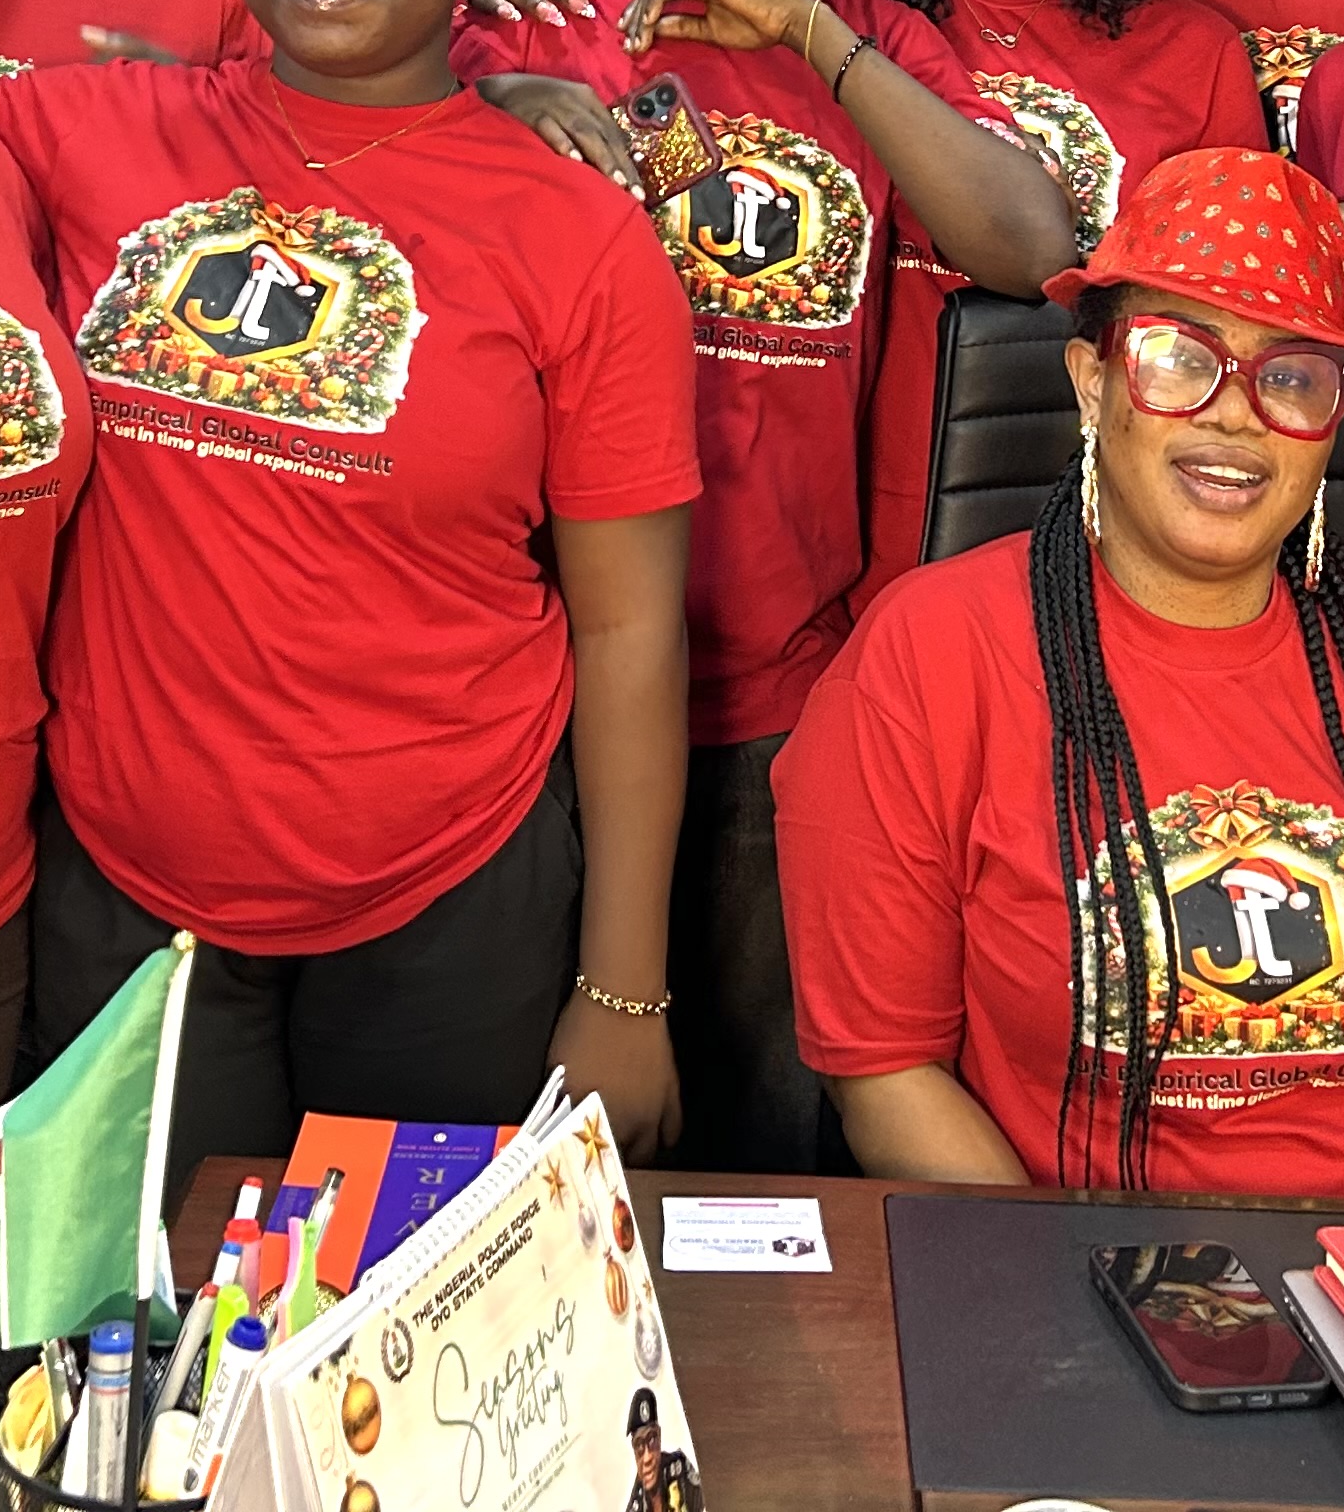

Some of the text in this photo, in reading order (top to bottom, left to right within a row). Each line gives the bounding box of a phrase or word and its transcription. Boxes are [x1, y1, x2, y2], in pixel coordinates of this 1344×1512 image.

[717, 346, 827, 368] global experience
[722, 326, 854, 360] Global Consult
[136, 424, 347, 485] in time global experience
[200, 416, 282, 451] Global
[288, 436, 394, 477] Consult
[1150, 1092, 1246, 1111] just in time
[412, 1197, 541, 1329] THE NIGERIA POLICE FORCE
[430, 1226, 534, 1333] OYO STATE COMMAND
[191, 1362, 228, 1468] marker
